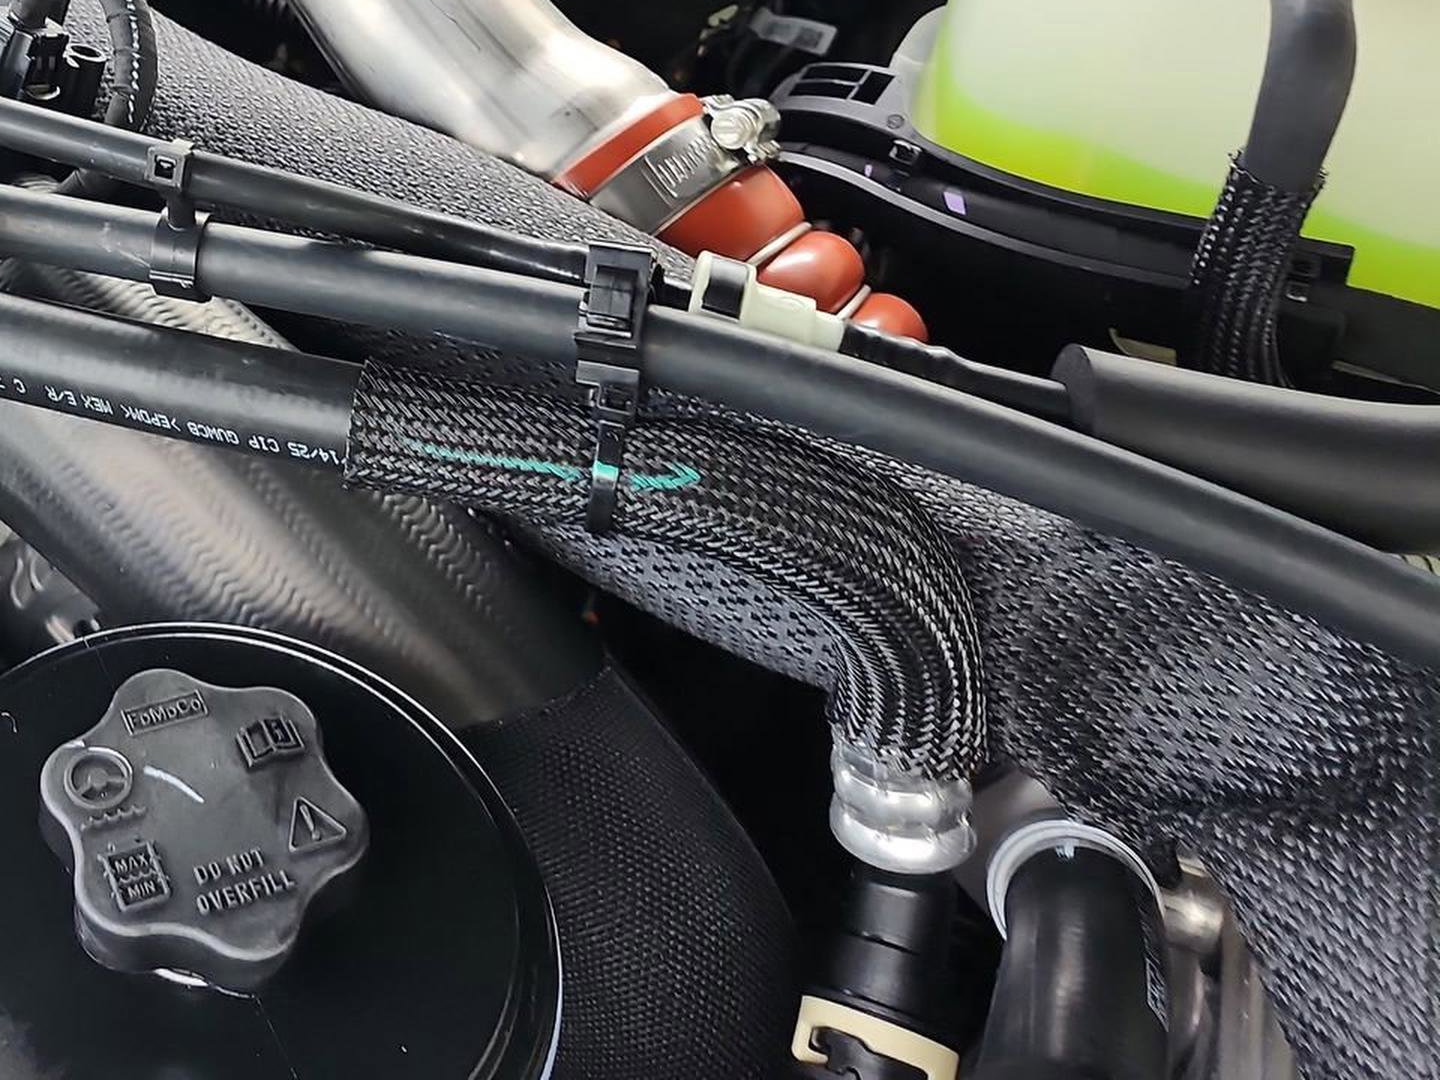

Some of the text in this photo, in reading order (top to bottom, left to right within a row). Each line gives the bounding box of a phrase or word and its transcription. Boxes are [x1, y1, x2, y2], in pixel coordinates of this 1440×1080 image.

[13, 378, 27, 394] C
[80, 393, 114, 415] MEX
[248, 435, 280, 453] CIP
[114, 853, 150, 873] MAX
[193, 848, 266, 885] DO NOT
[127, 881, 157, 899] MIN
[196, 870, 296, 915] OVERFILL
